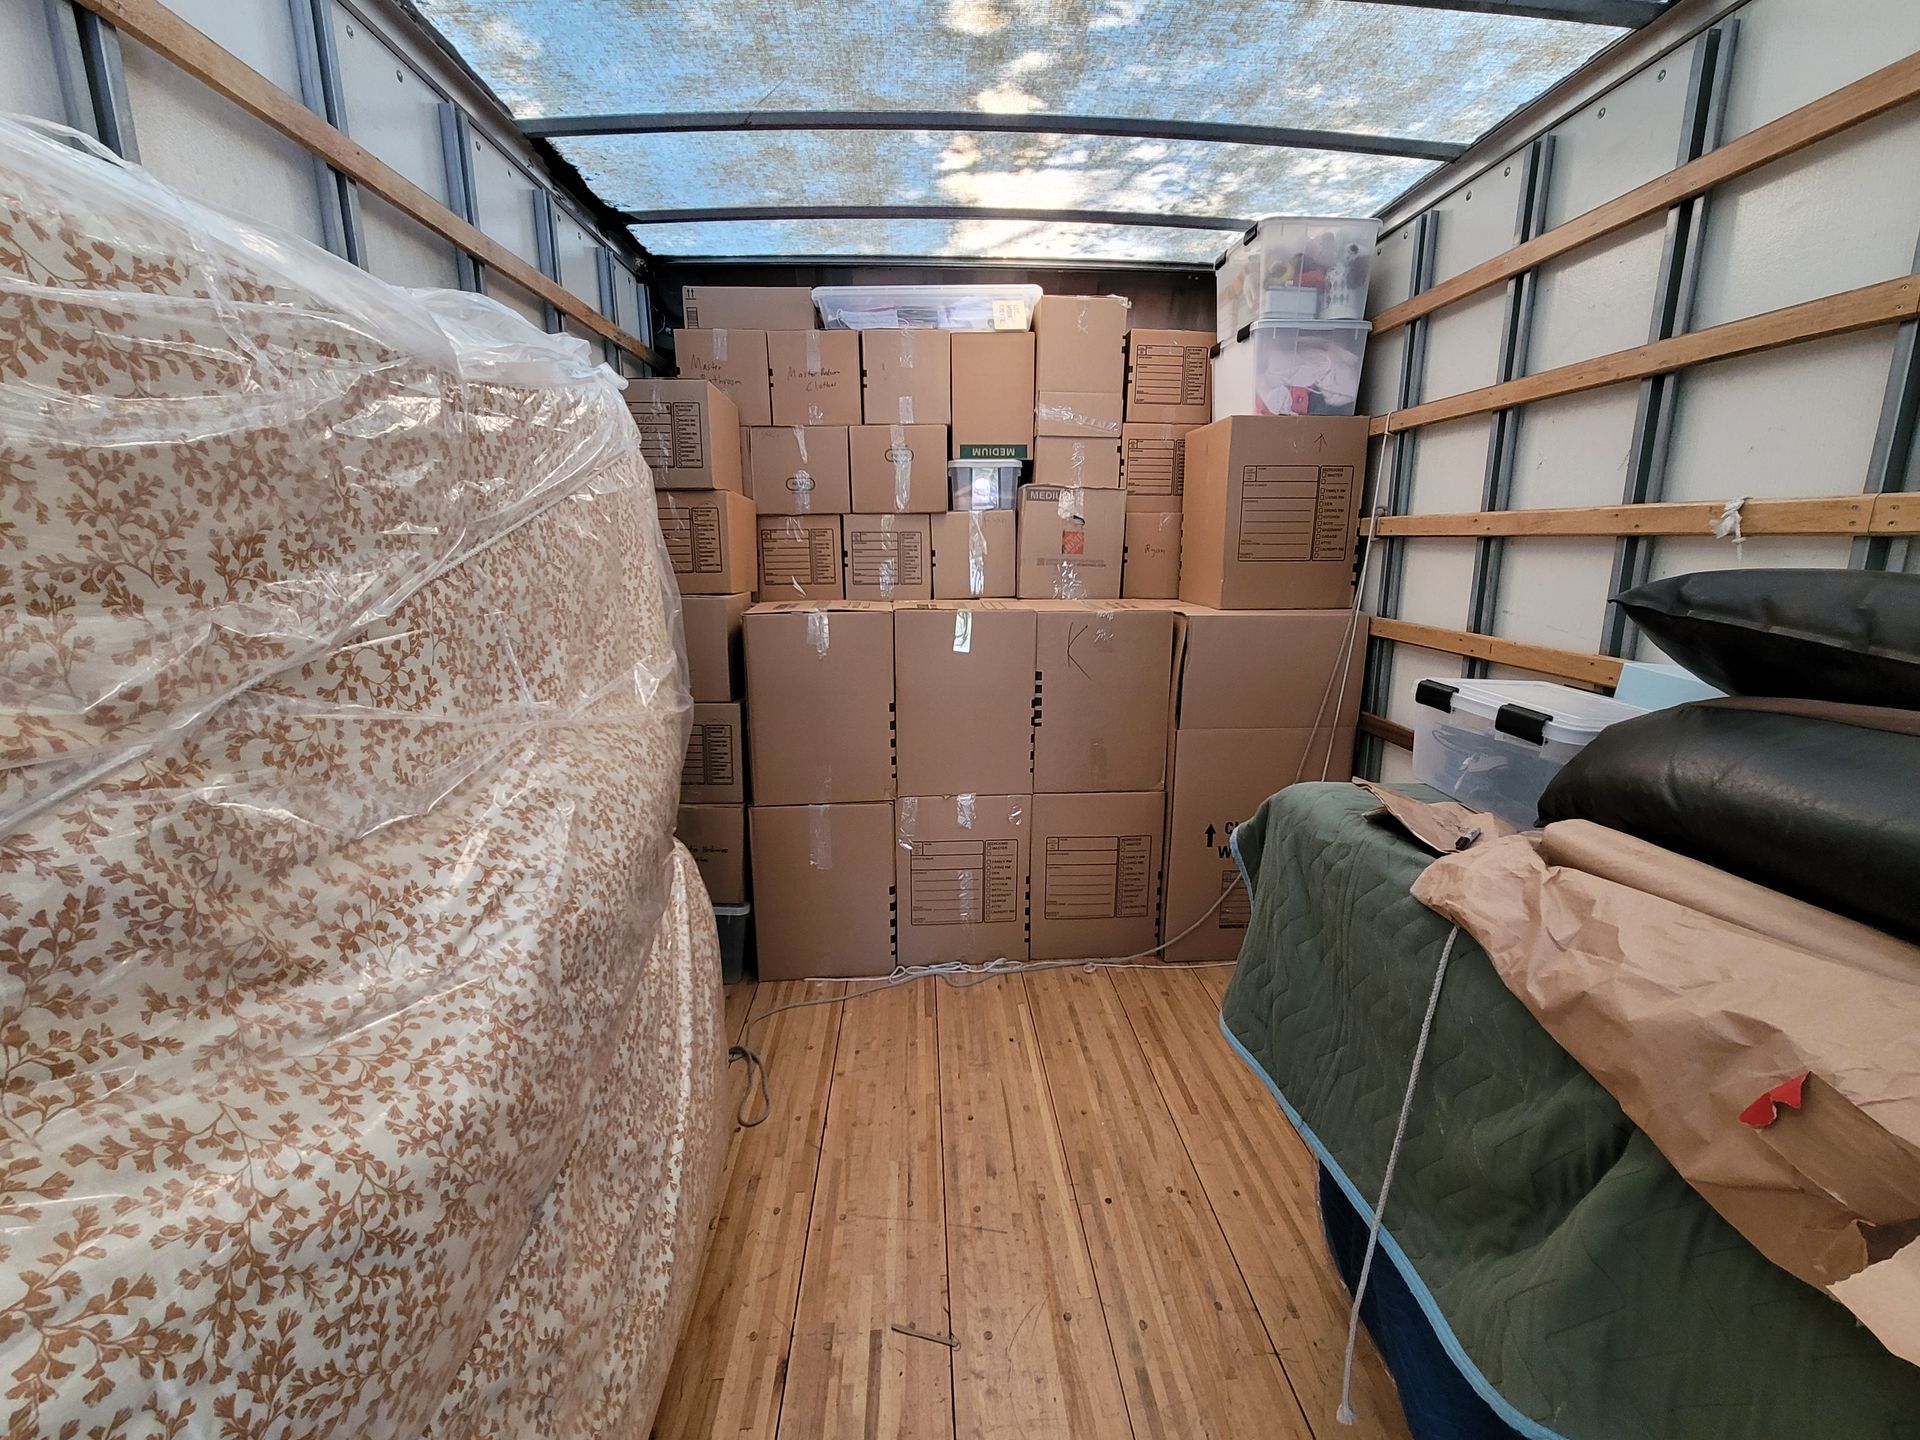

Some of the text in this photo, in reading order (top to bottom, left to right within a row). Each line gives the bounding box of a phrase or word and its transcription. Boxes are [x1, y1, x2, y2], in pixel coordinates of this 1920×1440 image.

[972, 447, 1015, 457] MEDIUM
[1144, 543, 1166, 558] Ryan
[1066, 621, 1092, 681] K
